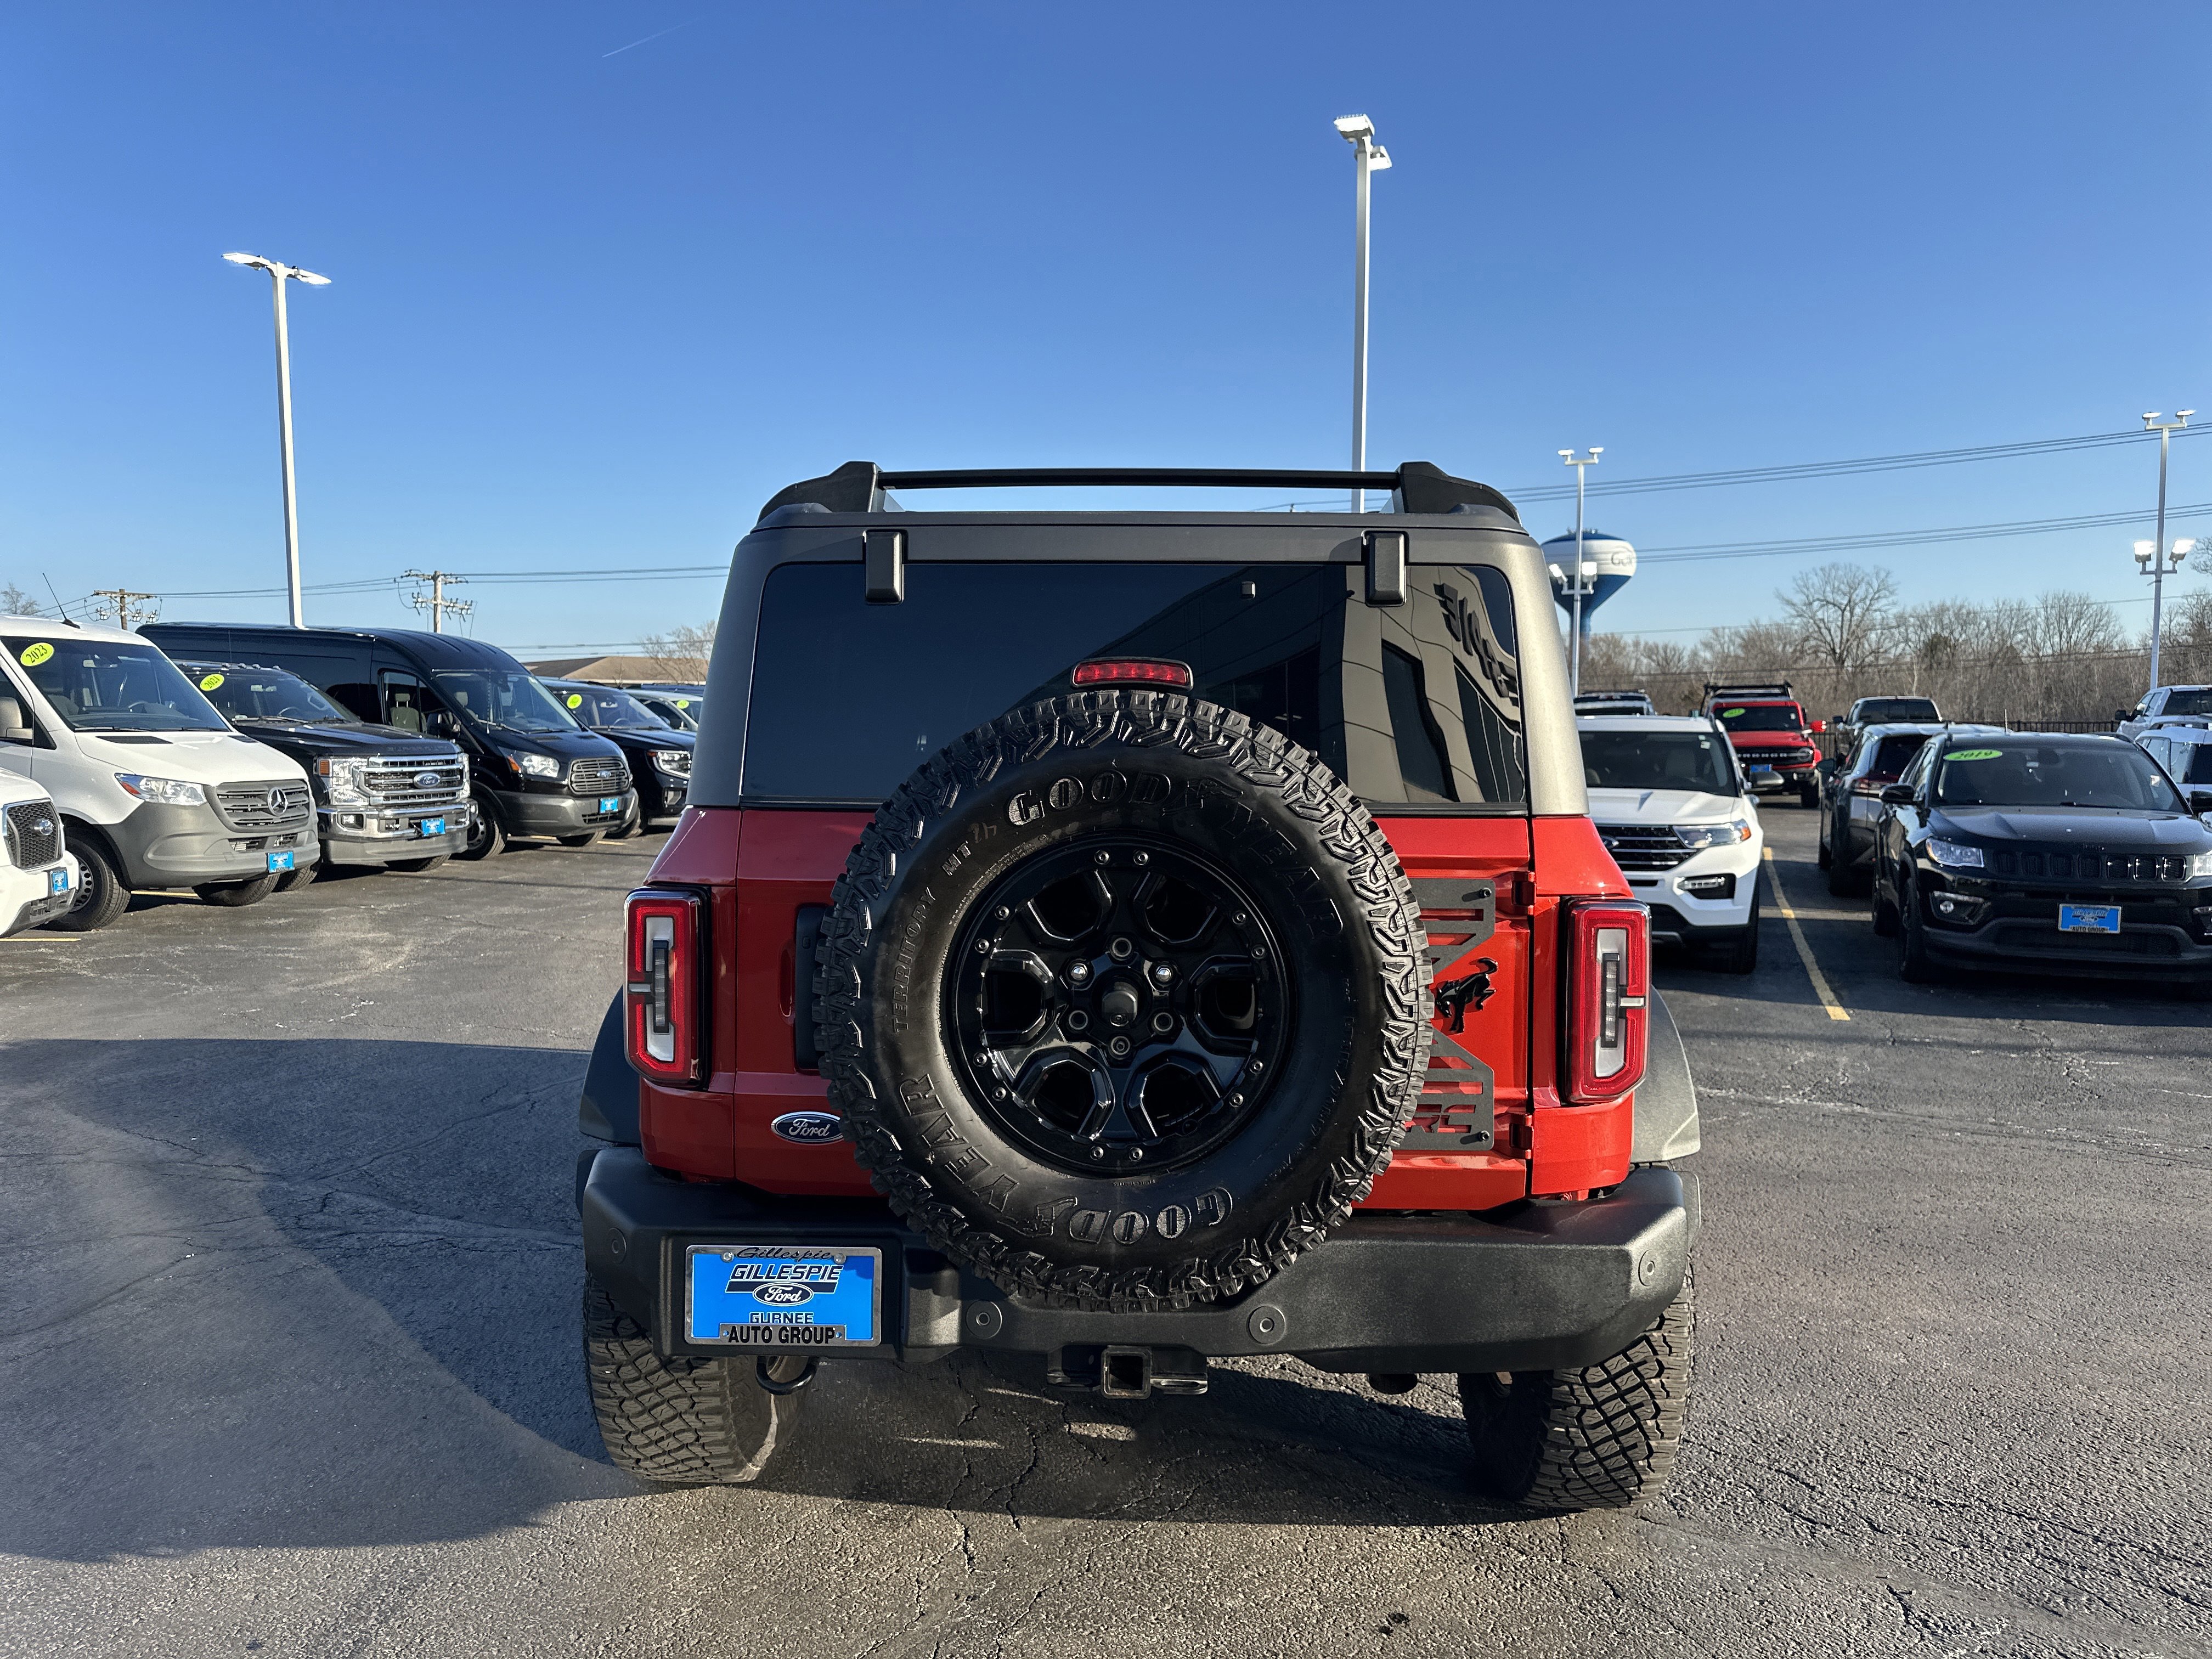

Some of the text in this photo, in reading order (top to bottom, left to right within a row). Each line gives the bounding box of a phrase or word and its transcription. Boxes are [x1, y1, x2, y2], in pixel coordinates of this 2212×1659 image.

[26, 645, 48, 663] 2023
[204, 675, 221, 689] 2021
[893, 840, 971, 1034] TERRITORY MT
[788, 1118, 831, 1137] Ford
[736, 1247, 832, 1262] Gillespie
[730, 1264, 844, 1280] GILLESPIE
[764, 1285, 803, 1302] Ford
[749, 1312, 814, 1324] GURNEE
[728, 1325, 836, 1344] AUTO GROUP
